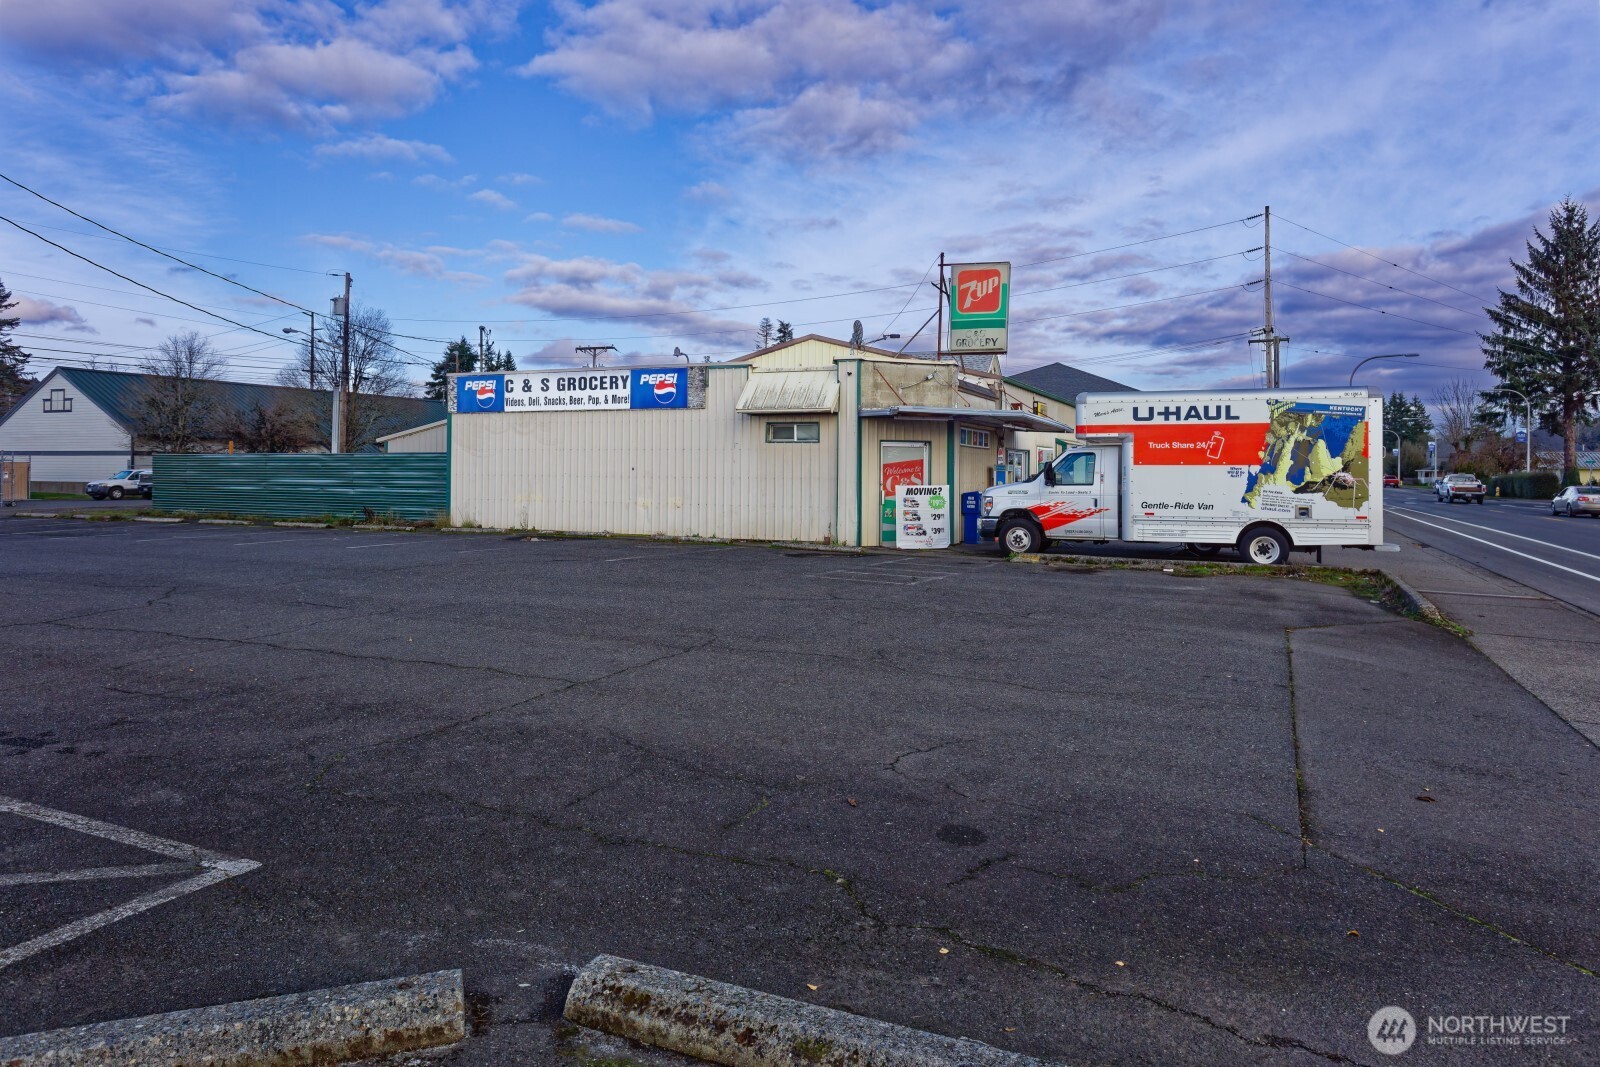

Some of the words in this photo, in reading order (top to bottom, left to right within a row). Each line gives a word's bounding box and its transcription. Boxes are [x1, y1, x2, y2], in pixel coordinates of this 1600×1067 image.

[505, 379, 514, 393] C
[521, 378, 532, 393] &
[540, 377, 550, 392] S
[556, 375, 630, 392] GROCERY
[640, 373, 678, 385] PEPSI
[465, 380, 497, 391] PEPSI
[505, 398, 526, 408] Videos,
[528, 397, 541, 407] Deli,
[543, 396, 567, 406] Snacks,
[569, 395, 585, 406] Beer,
[587, 395, 601, 406] Pop,
[603, 395, 609, 404] &
[611, 393, 630, 404] More!
[1132, 405, 1240, 422] U-HAUL
[1148, 441, 1170, 449] Truck
[1172, 441, 1194, 449] Share
[1196, 440, 1215, 450] 24/7
[885, 466, 914, 475] Welcome
[905, 487, 943, 496] MOVING?
[1140, 501, 1195, 510] Gentle-Ride
[1197, 502, 1214, 510] Van
